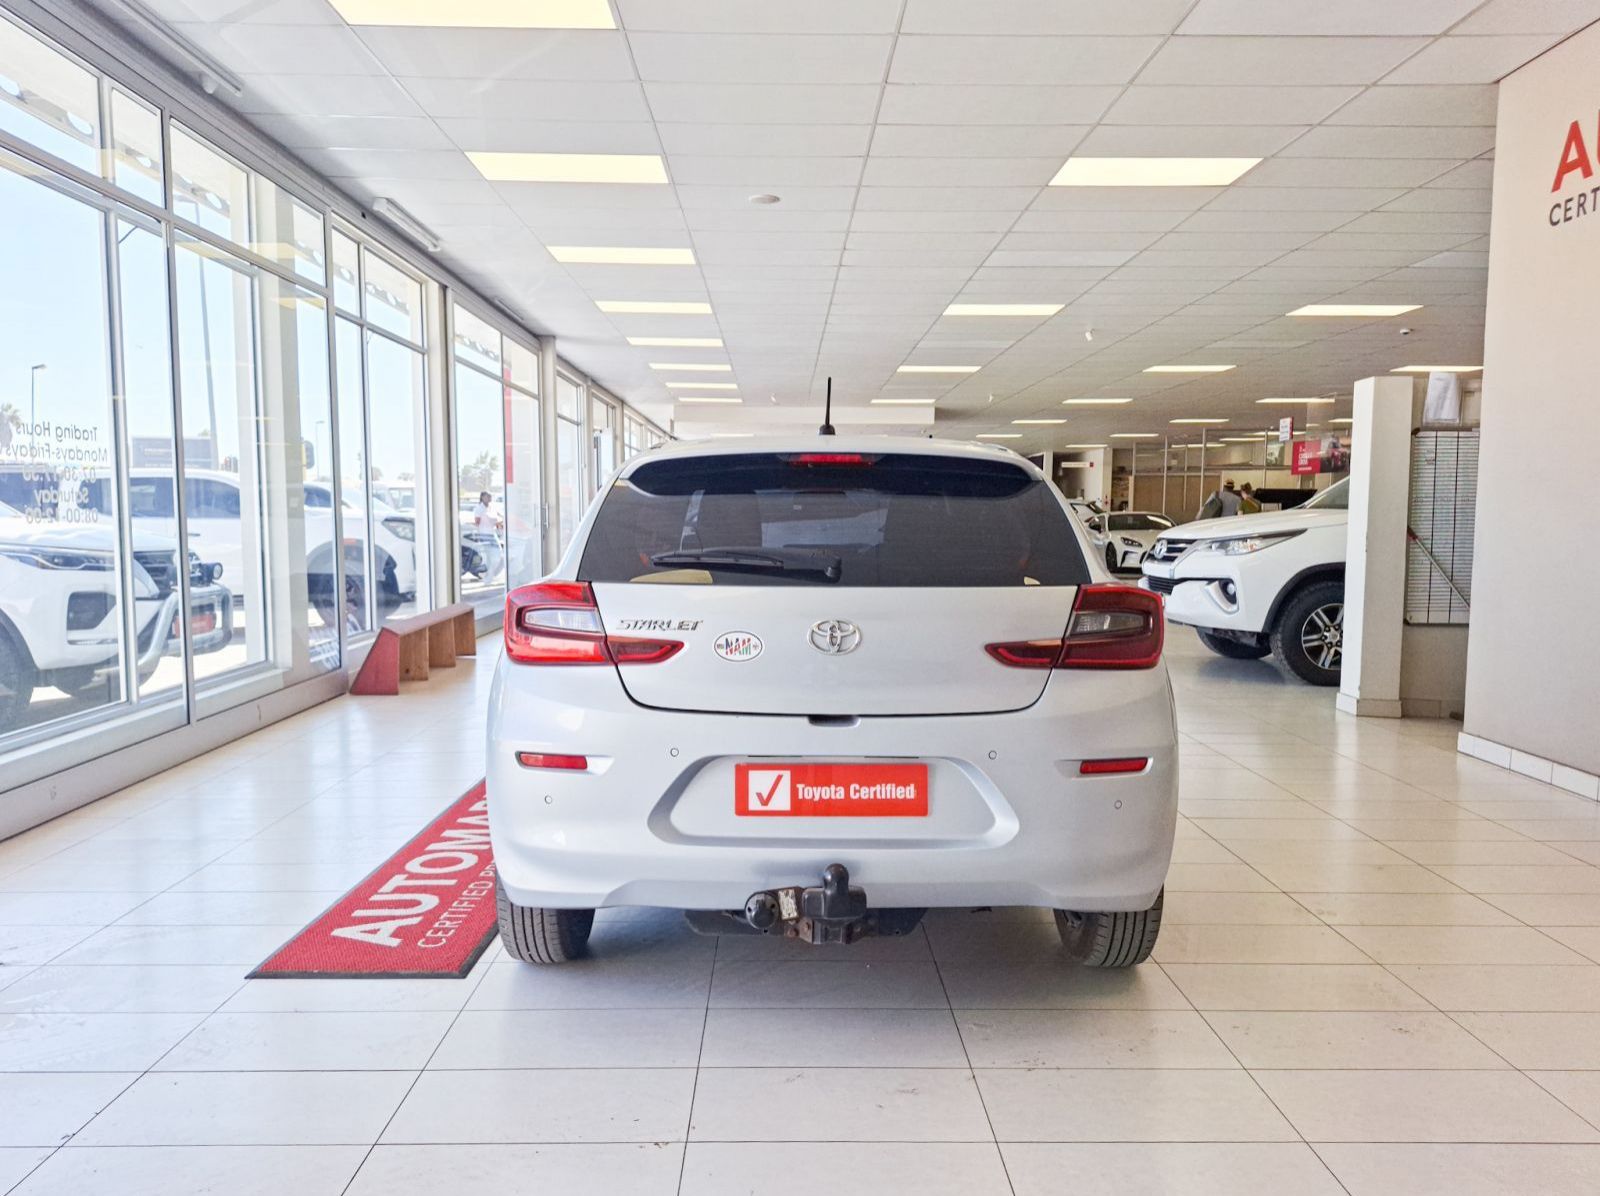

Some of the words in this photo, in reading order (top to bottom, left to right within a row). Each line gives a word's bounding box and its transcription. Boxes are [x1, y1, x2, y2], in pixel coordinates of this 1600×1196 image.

[1551, 109, 1600, 193] A
[616, 619, 704, 632] STARLET
[725, 637, 752, 656] NAM
[796, 783, 845, 800] Toyota
[849, 783, 915, 799] Certified
[330, 794, 491, 948] AUTOMA
[417, 880, 493, 949] CERTIFIED
